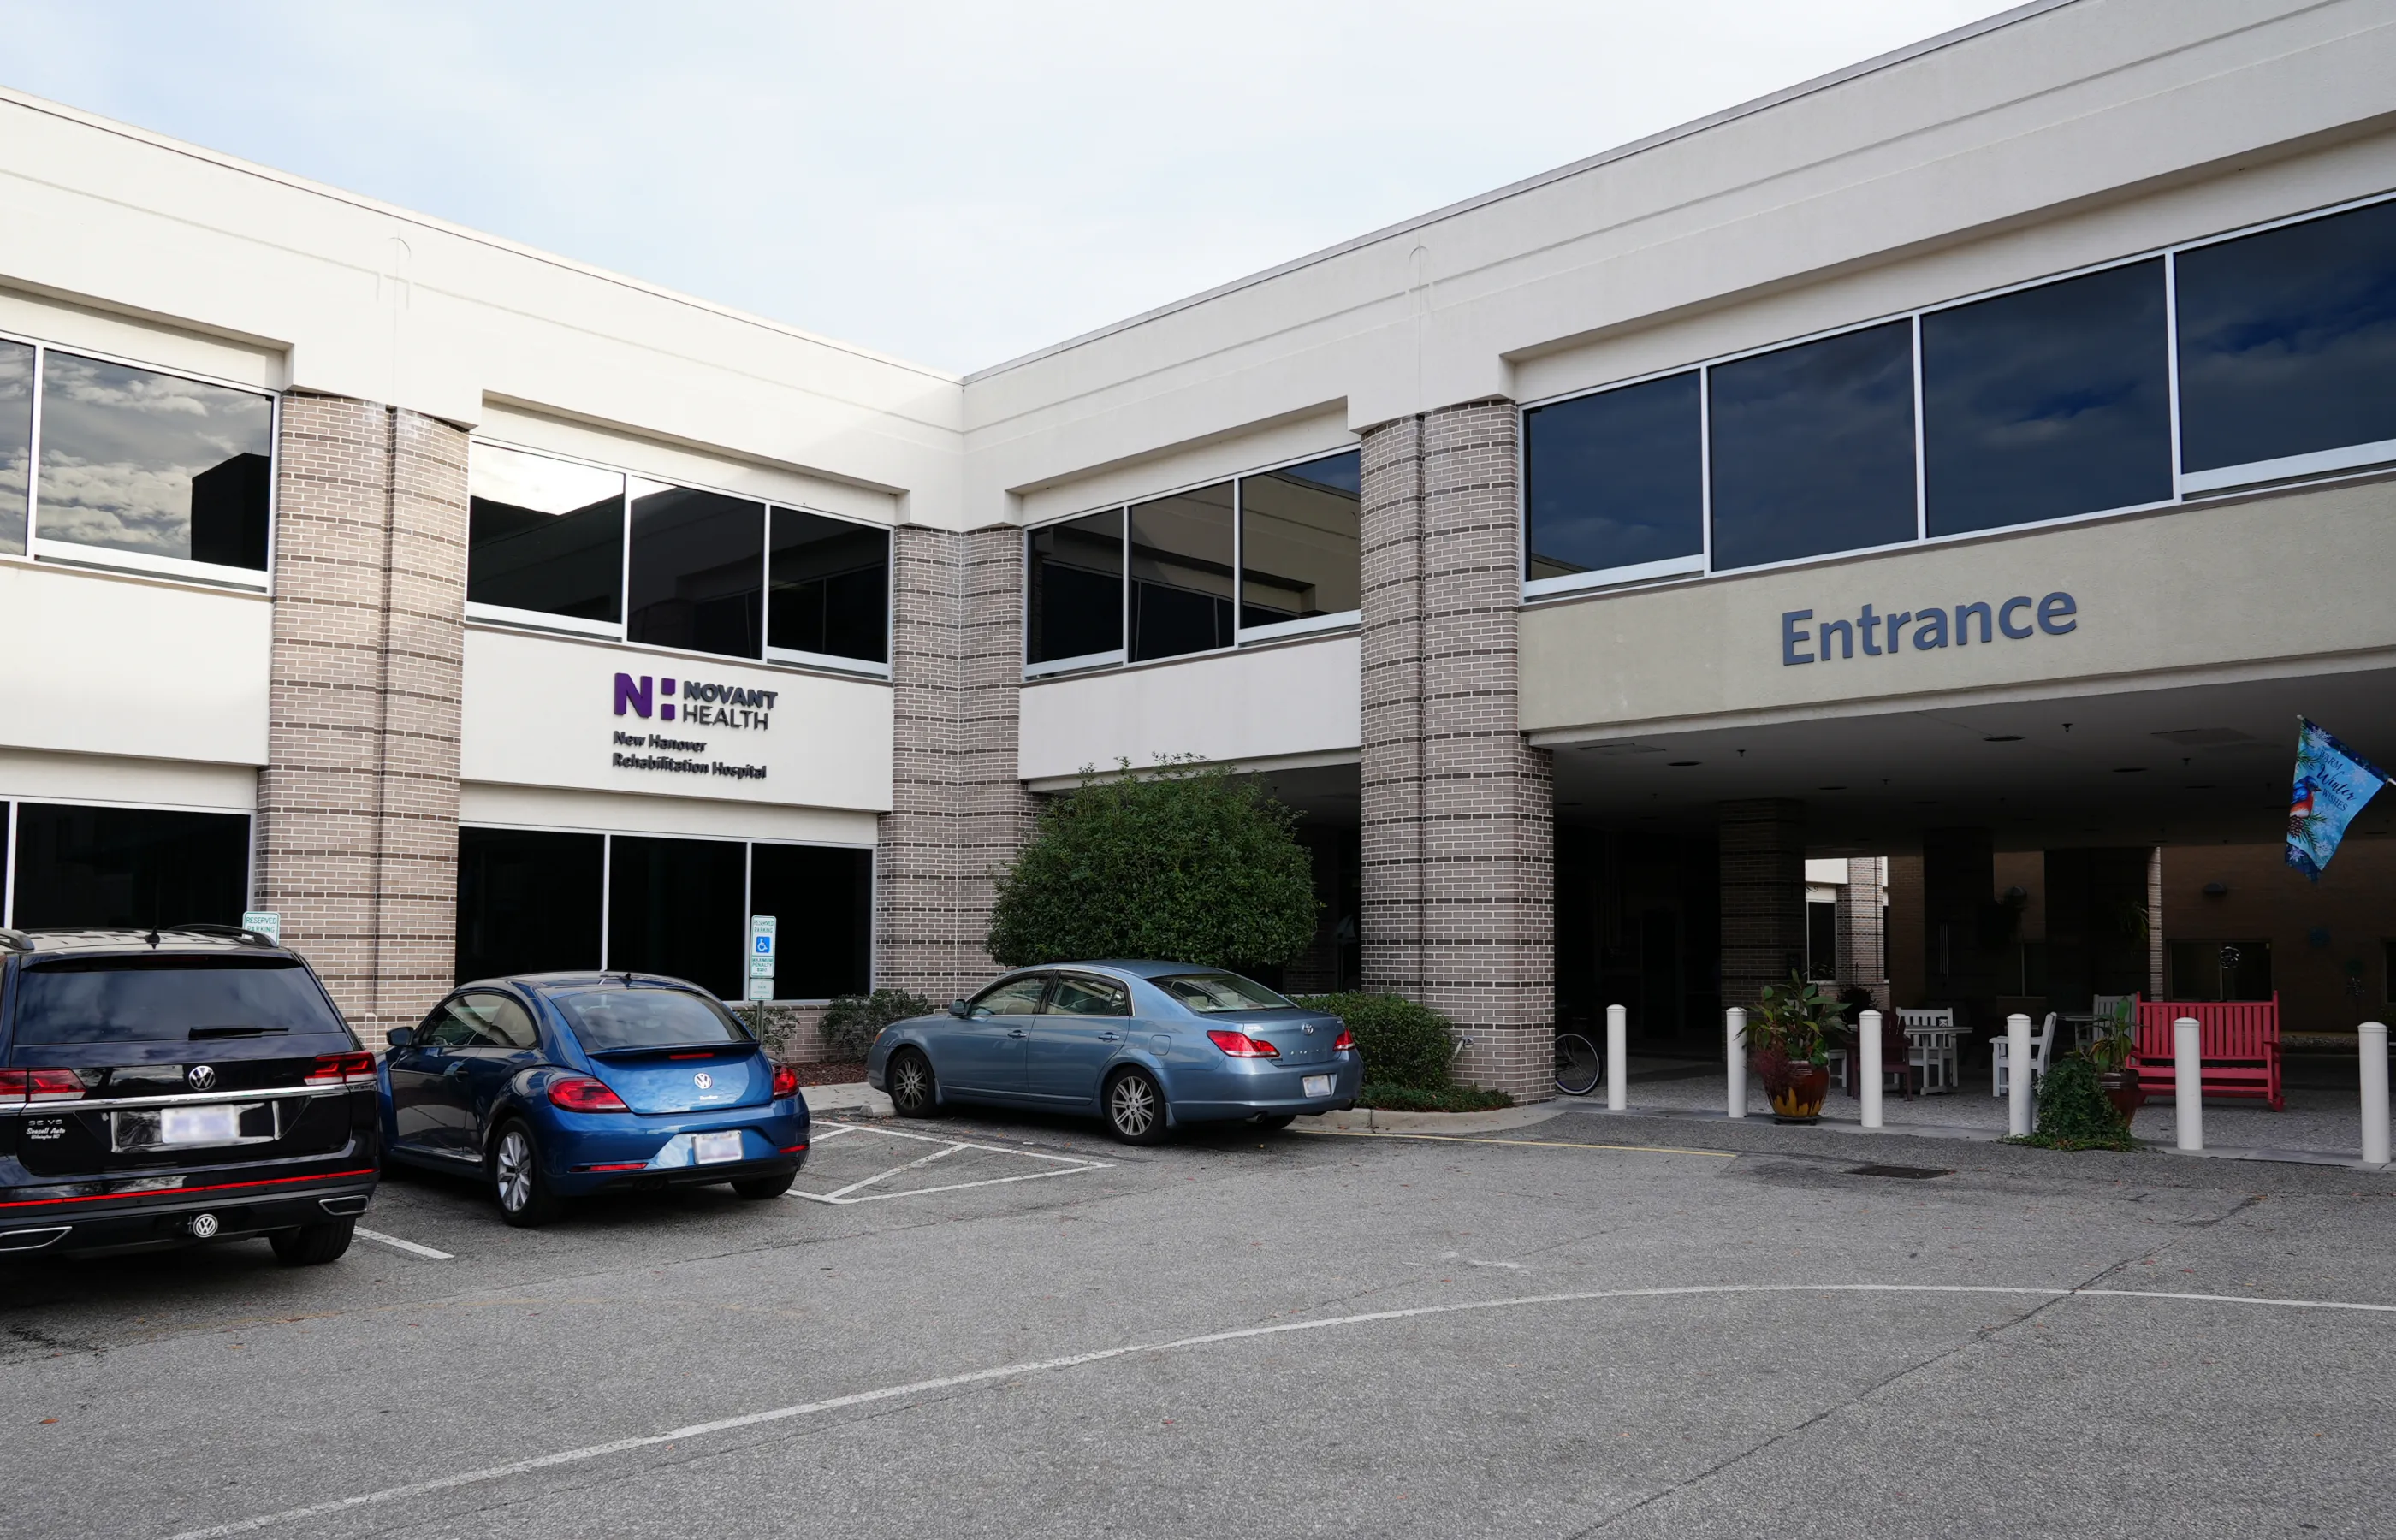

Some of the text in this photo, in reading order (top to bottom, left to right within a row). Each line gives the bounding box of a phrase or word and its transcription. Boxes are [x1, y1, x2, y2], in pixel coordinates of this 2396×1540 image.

[1782, 591, 2077, 666] Entrance
[683, 680, 778, 710] NOVANT
[682, 703, 768, 731] HEALTH
[613, 730, 708, 753] New Hanover
[612, 752, 767, 780] Rehabilitation Hospital
[2318, 749, 2343, 771] WARM
[2316, 763, 2357, 801] Winter
[2322, 788, 2348, 812] WISHES
